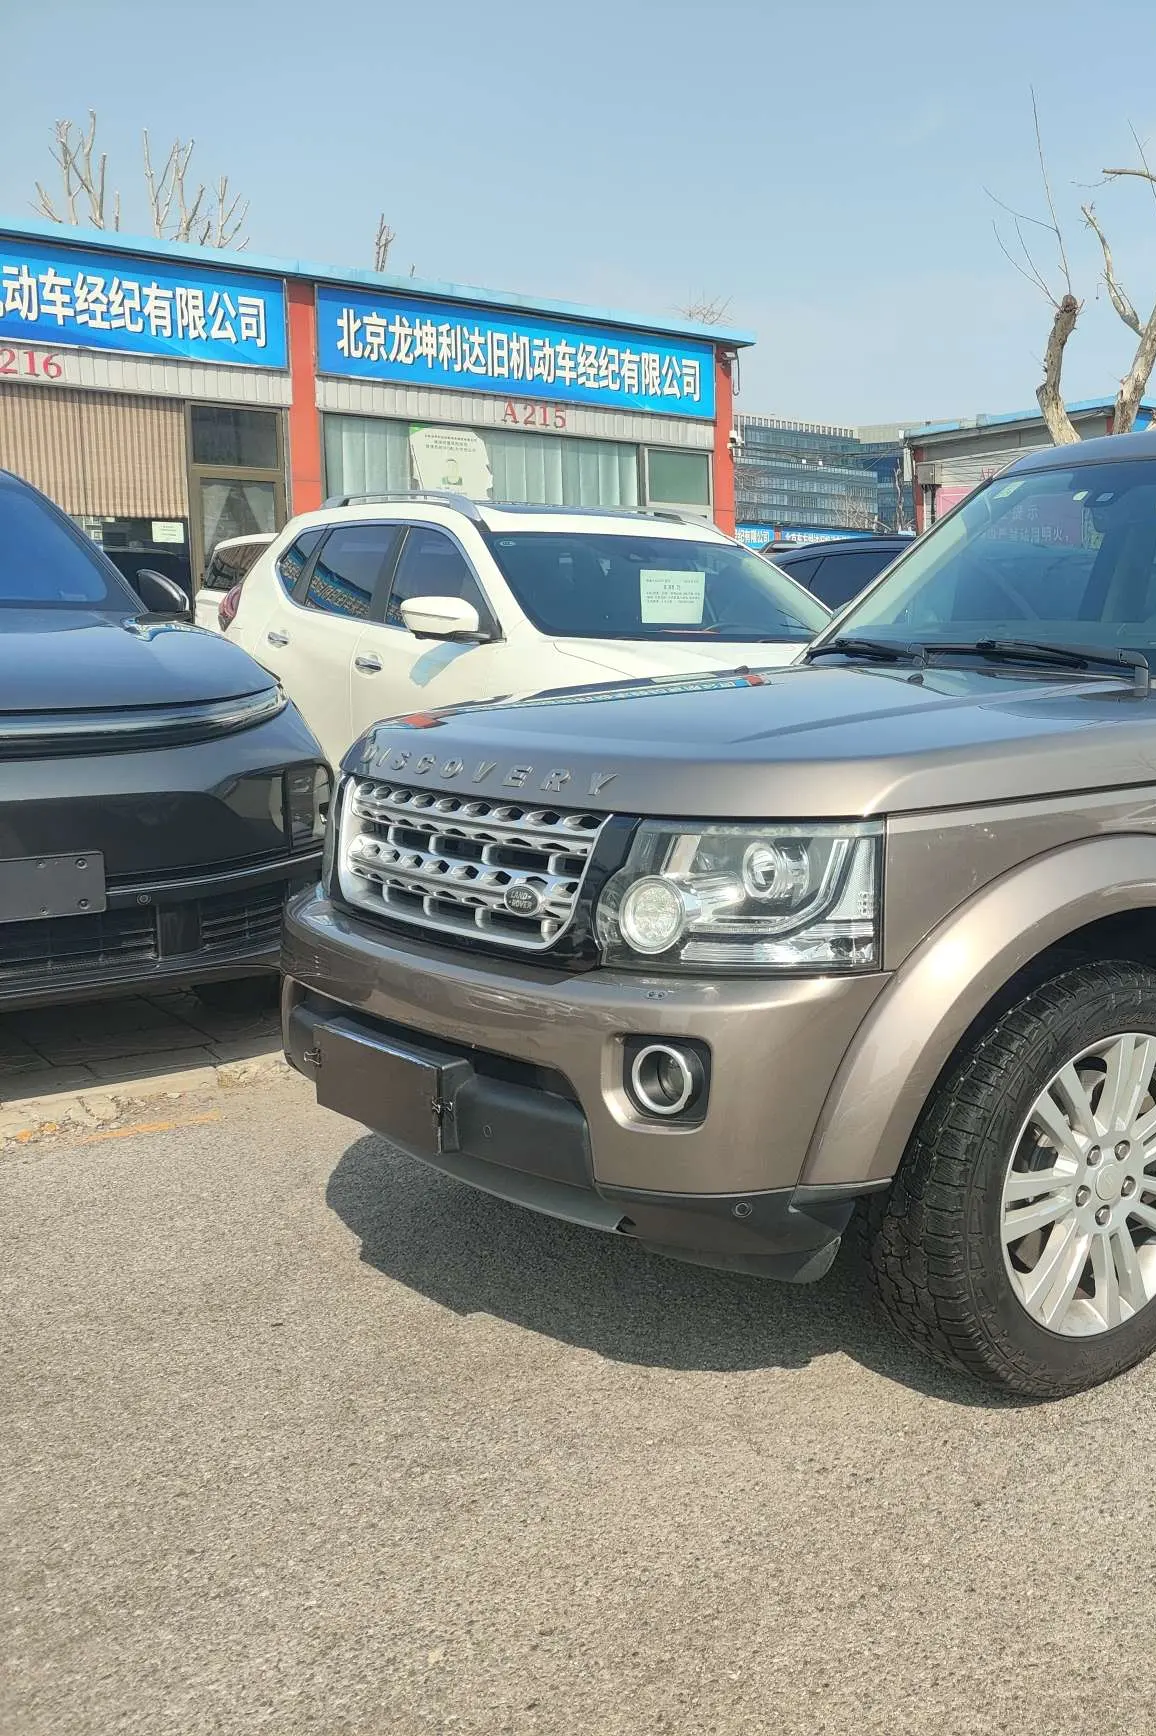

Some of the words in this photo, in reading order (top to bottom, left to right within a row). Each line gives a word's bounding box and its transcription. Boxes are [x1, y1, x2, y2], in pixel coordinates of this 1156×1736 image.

[0, 264, 267, 348] 动车经纪有限公司
[336, 307, 701, 402] 北京龙坤利达旧机动车经纪有限公司
[501, 399, 566, 429] A215
[736, 529, 770, 543] 纪有限公司
[360, 740, 619, 796] DISCOVERY
